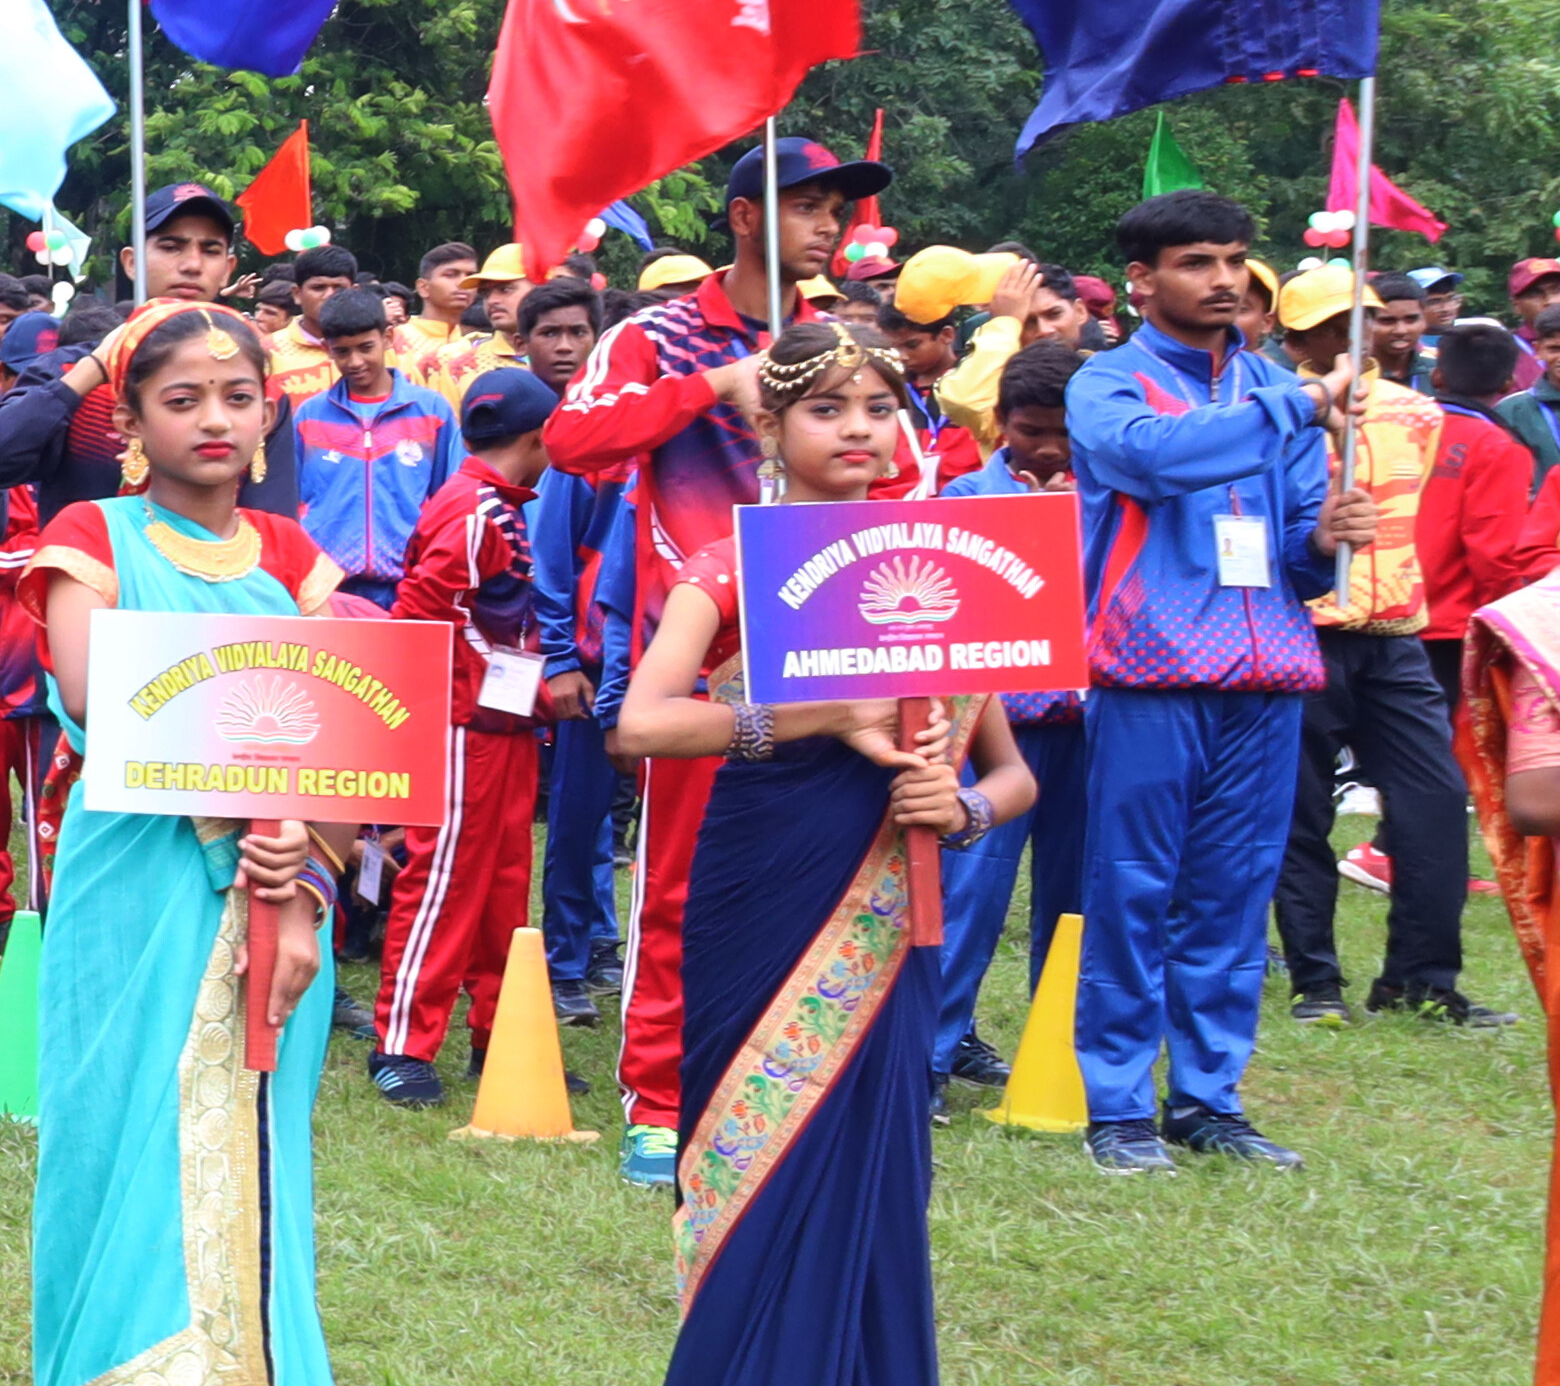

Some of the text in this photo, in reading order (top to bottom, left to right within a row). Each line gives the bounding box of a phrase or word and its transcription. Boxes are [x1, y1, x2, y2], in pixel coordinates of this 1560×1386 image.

[777, 522, 1047, 611] KENDRIYA VIDYALAYA SANGATHAN
[128, 641, 411, 730] KENDRIYA VIDYALAYA SANGATHAN
[782, 639, 1051, 679] AHMEDABAD REGION
[125, 760, 411, 799] DEHRADUN REGION
